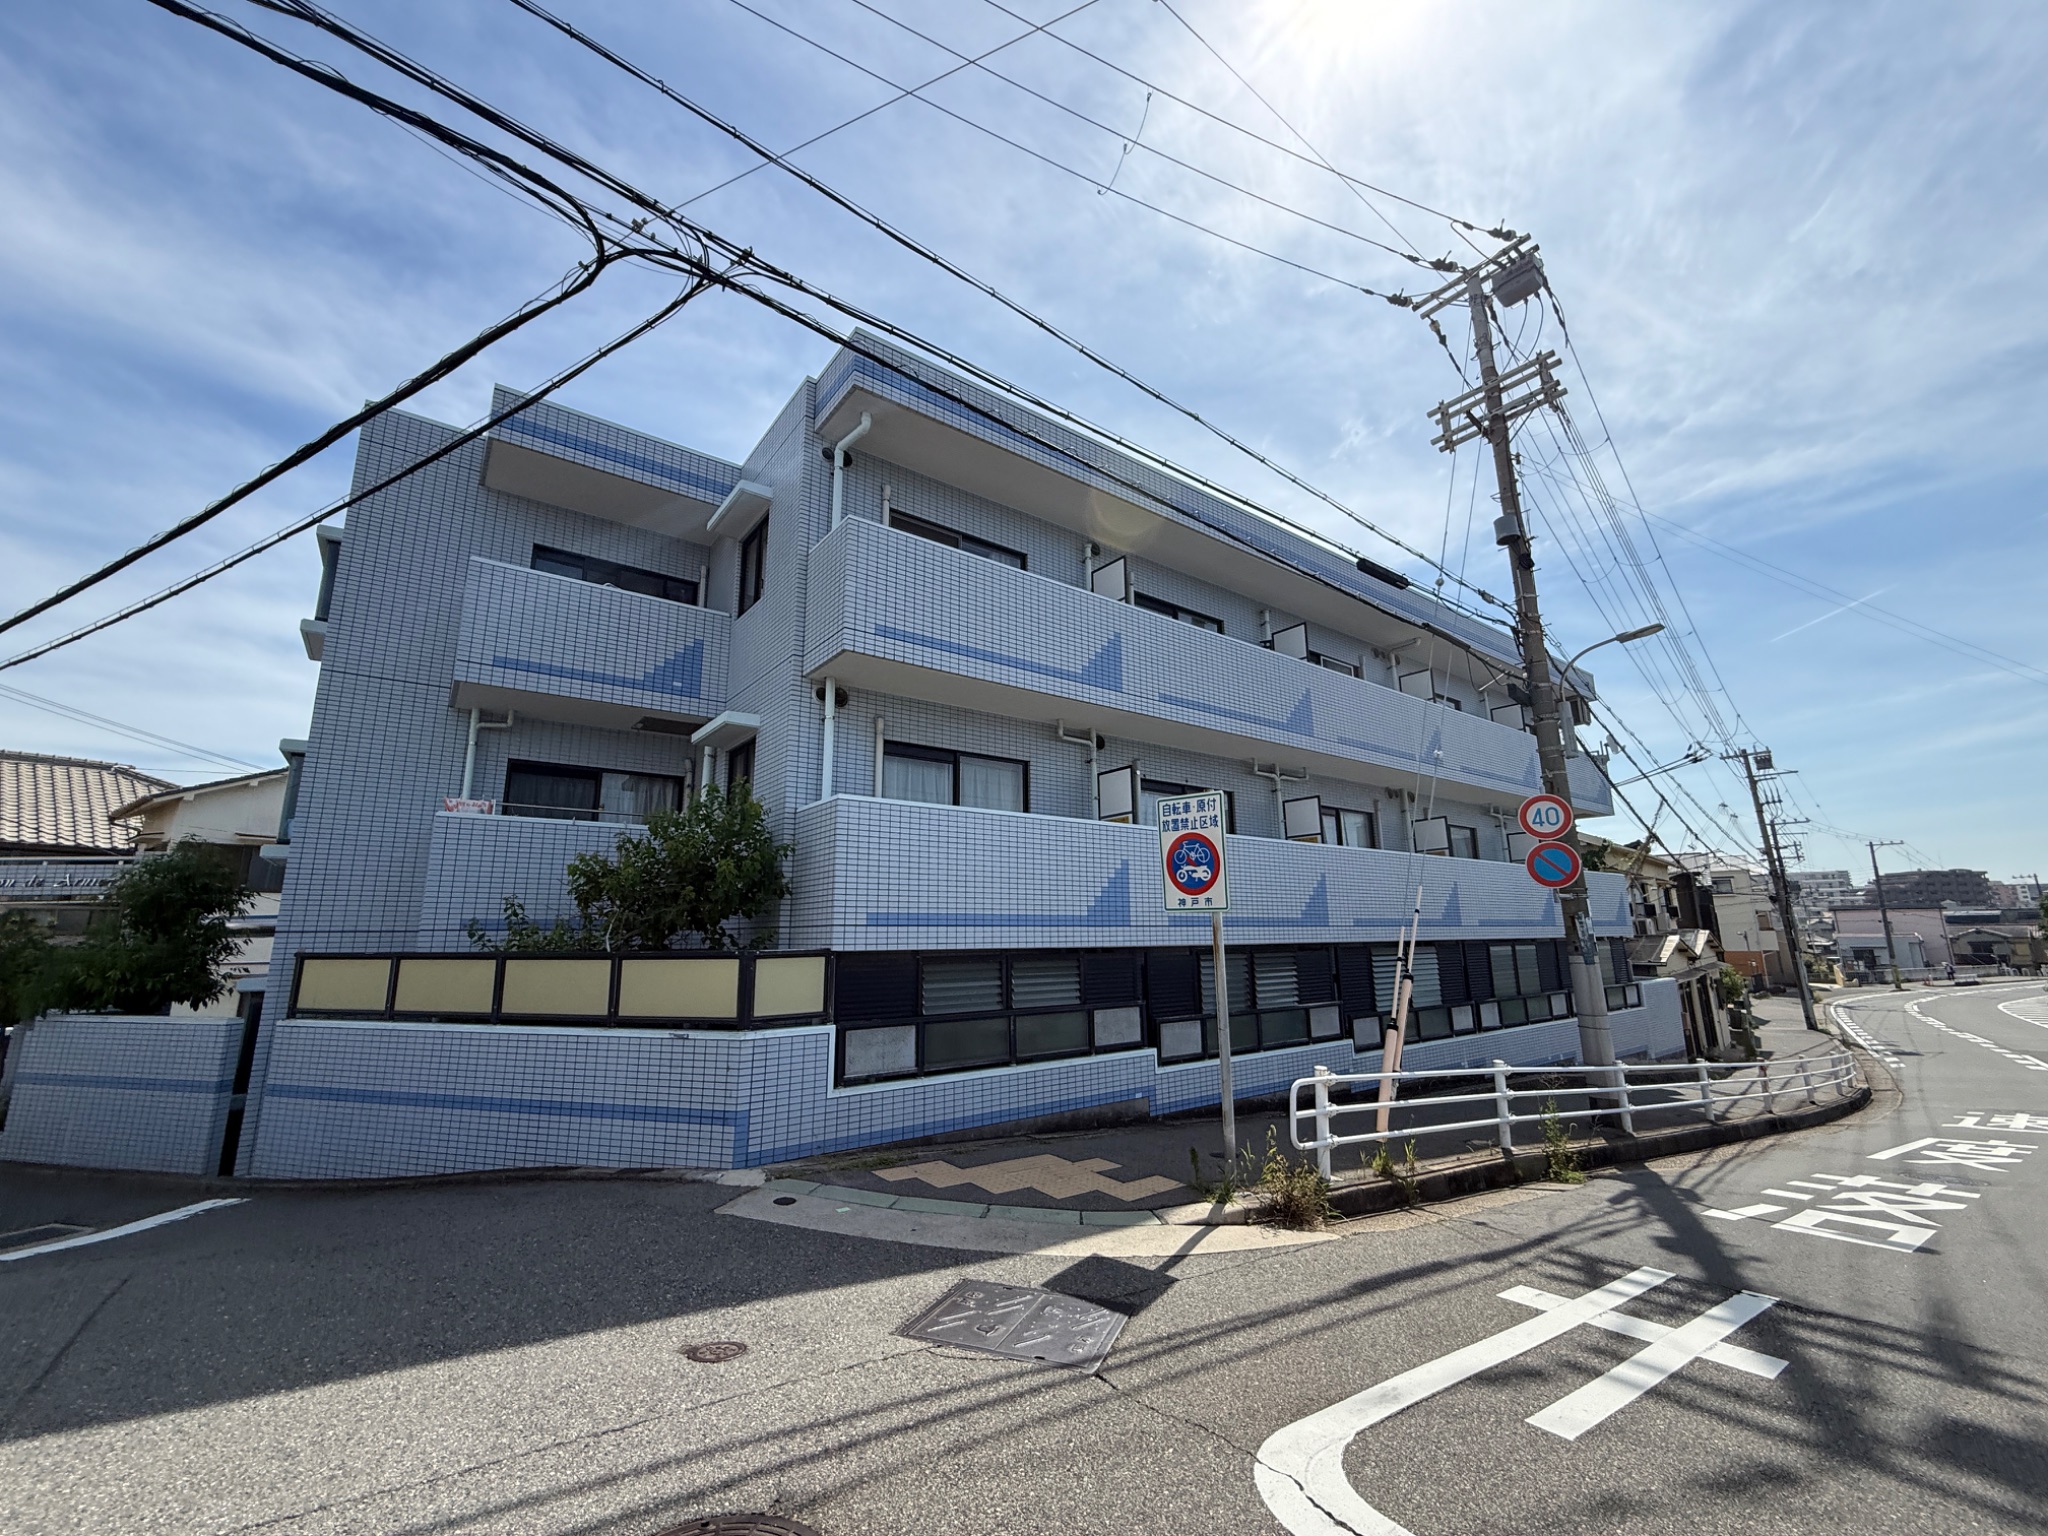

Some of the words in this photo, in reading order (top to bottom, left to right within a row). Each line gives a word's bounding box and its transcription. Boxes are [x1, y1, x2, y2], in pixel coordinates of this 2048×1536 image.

[1161, 814, 1219, 833] 放置禁止区域
[1532, 806, 1560, 827] 40
[1177, 896, 1213, 908] 神戸市
